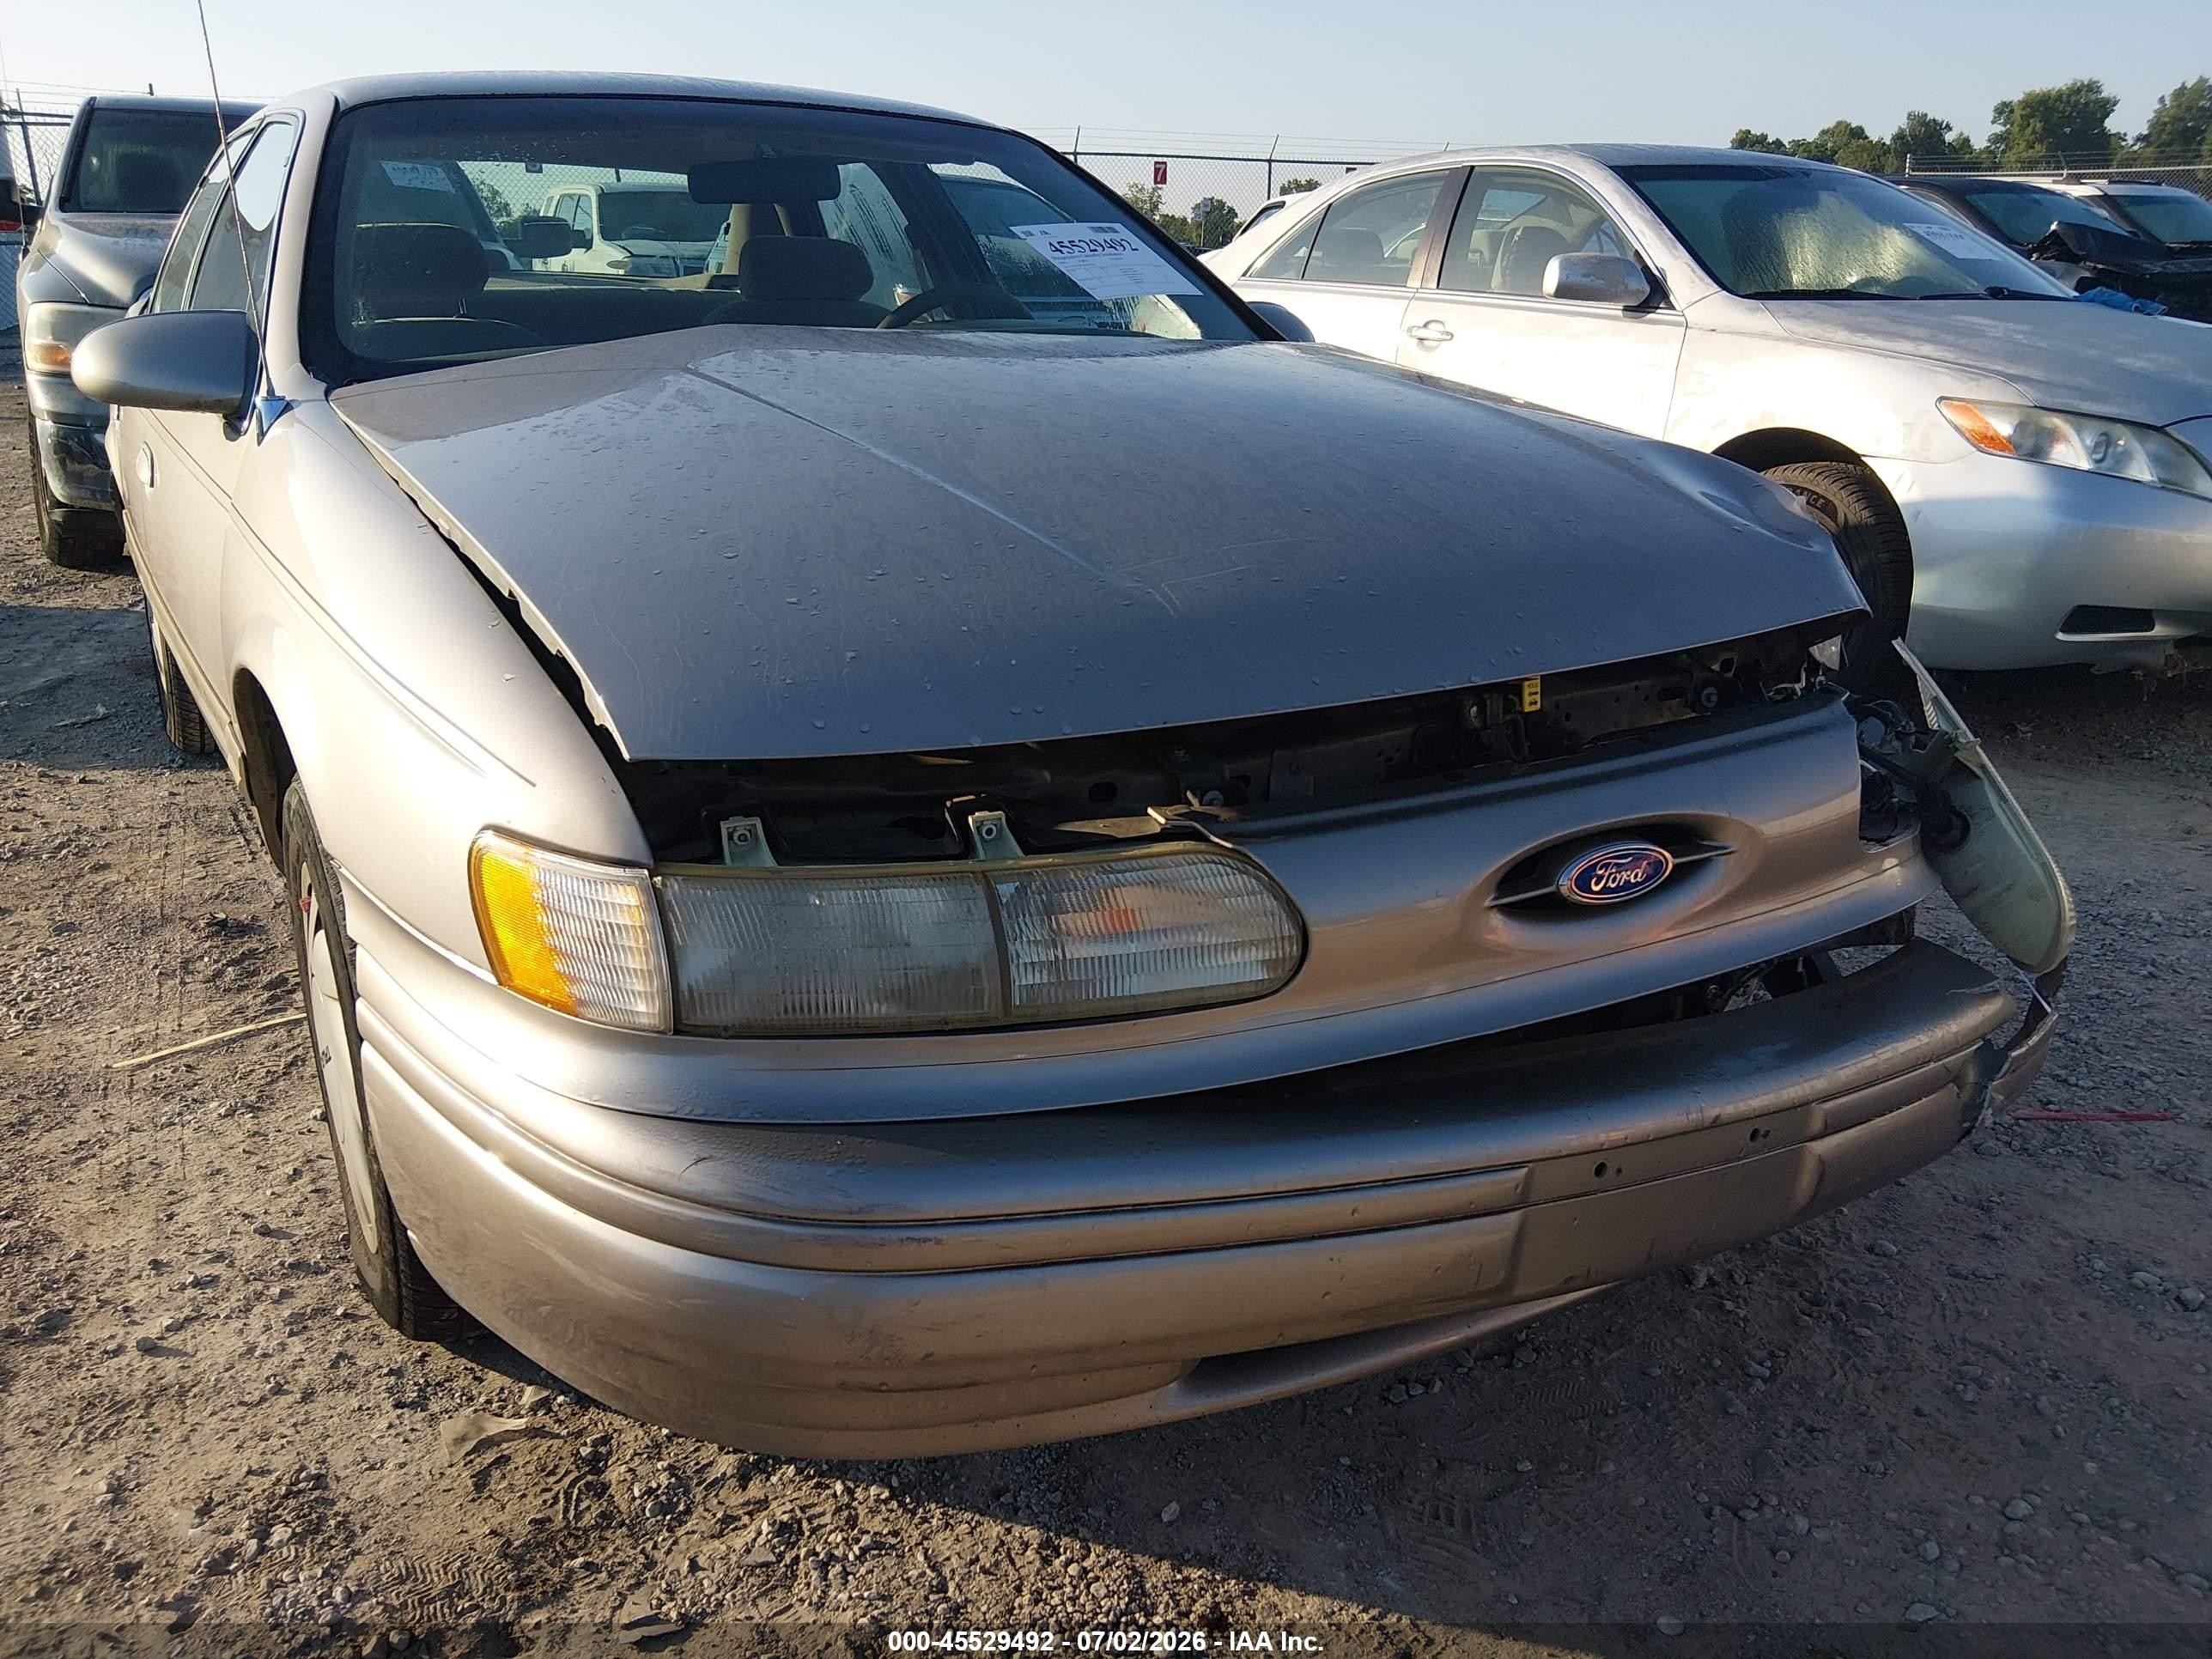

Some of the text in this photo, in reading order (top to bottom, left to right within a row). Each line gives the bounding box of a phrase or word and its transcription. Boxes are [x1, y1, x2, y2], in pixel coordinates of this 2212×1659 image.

[1155, 164, 1166, 182] 7
[1048, 239, 1139, 255] 45529492
[1590, 856, 1648, 892] Ford
